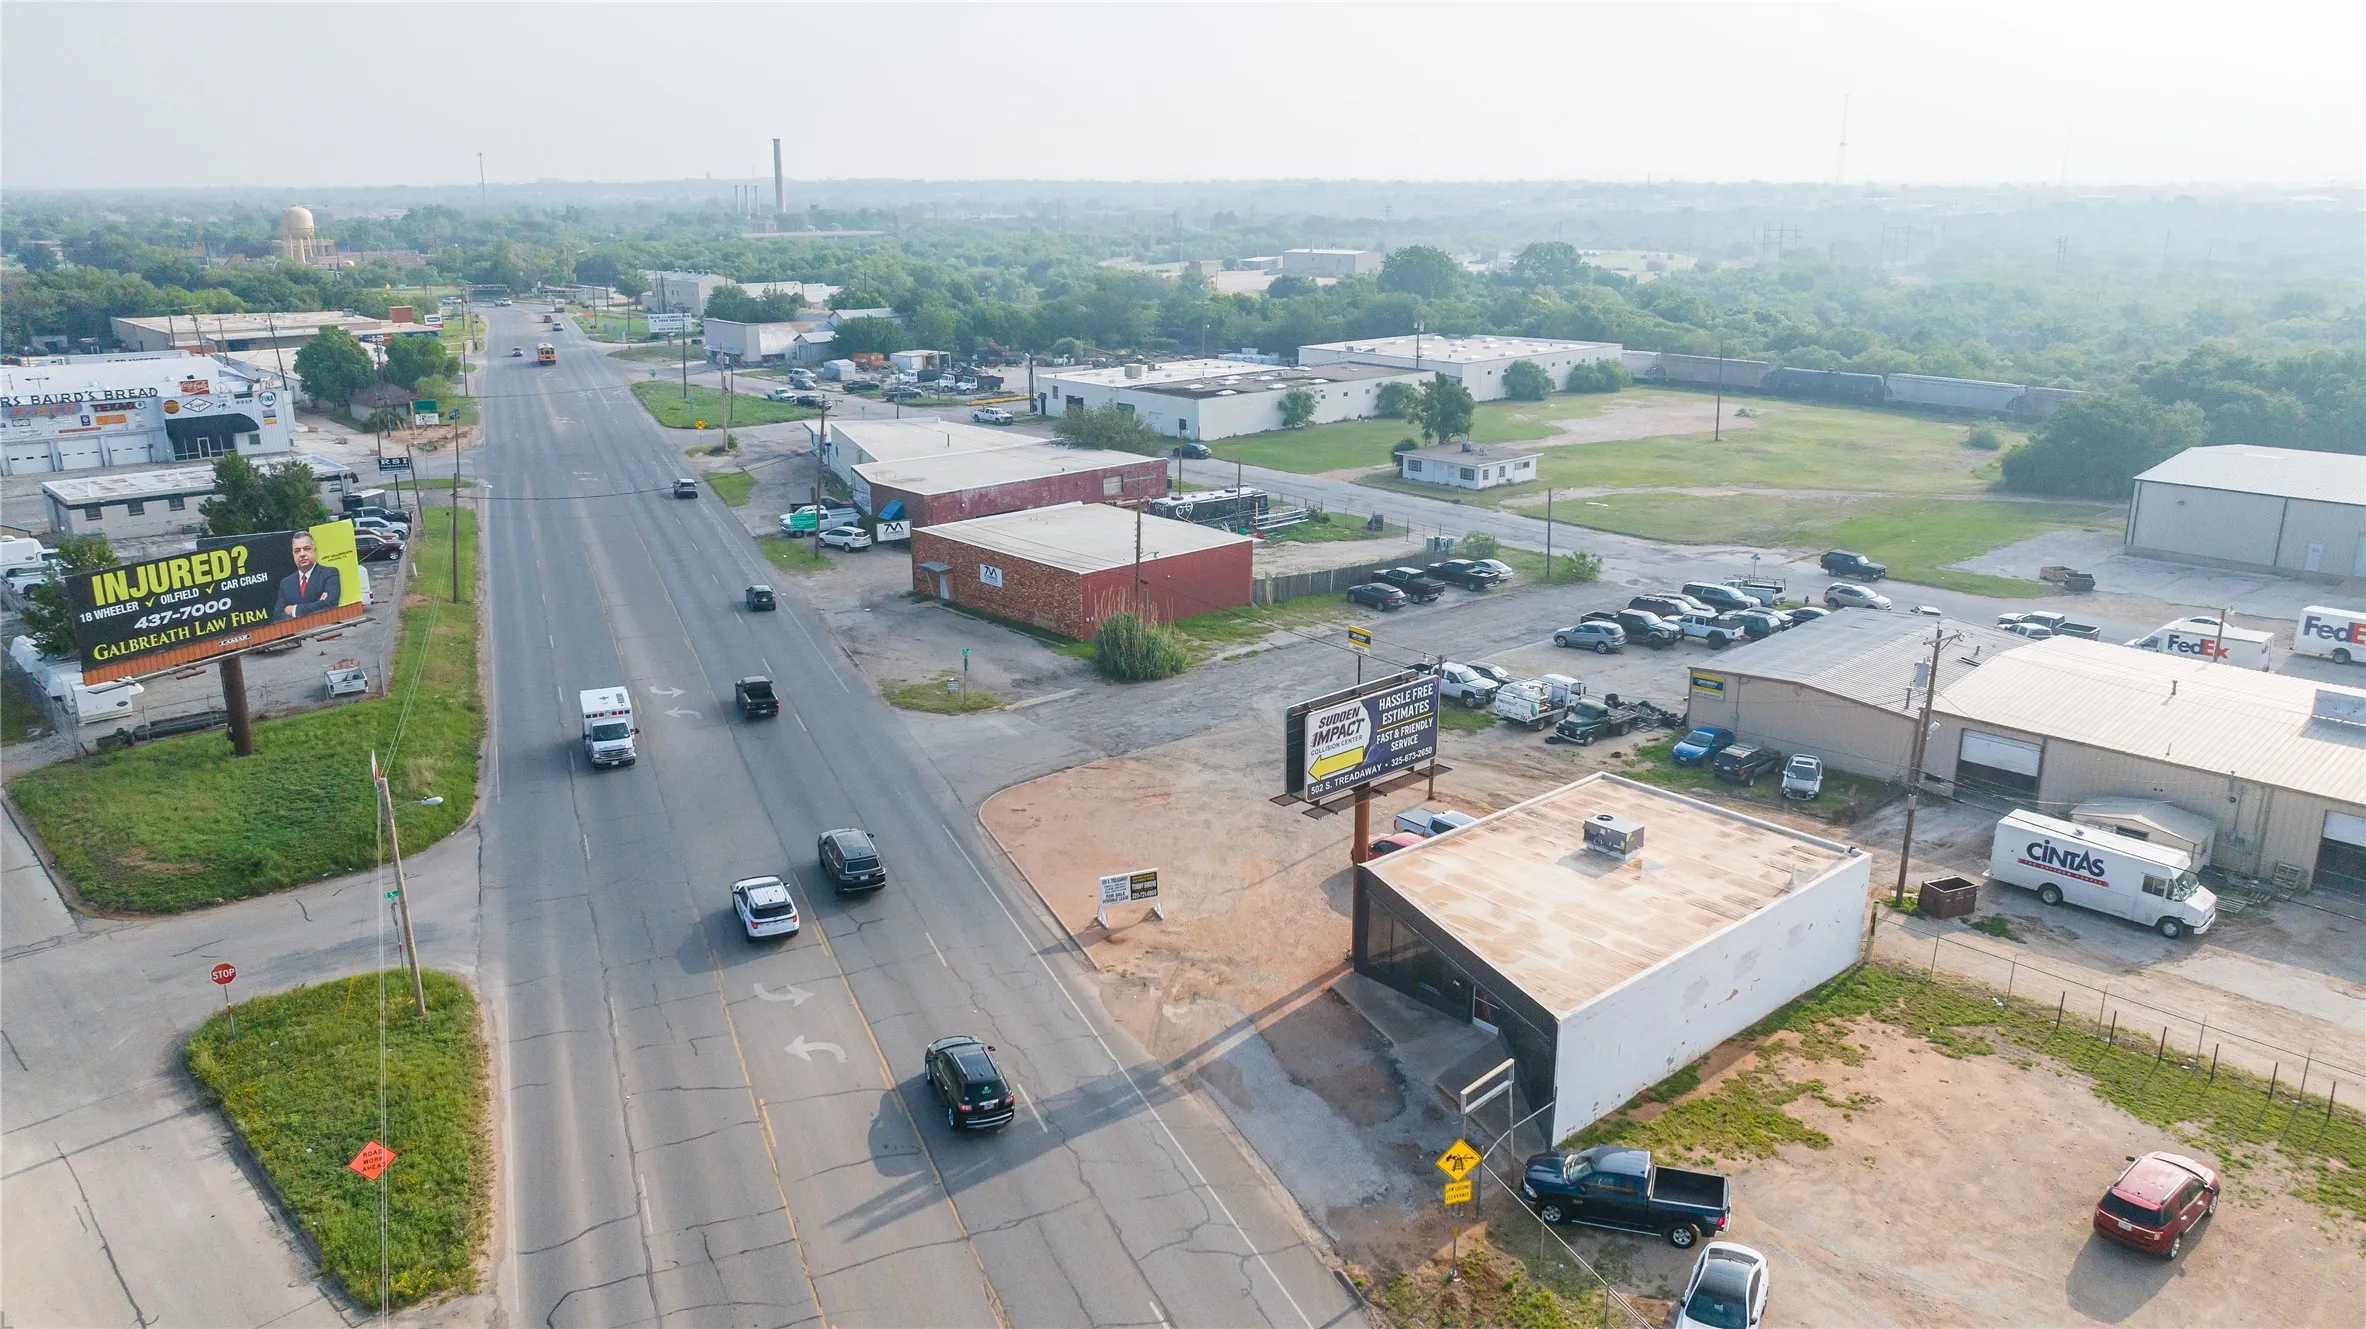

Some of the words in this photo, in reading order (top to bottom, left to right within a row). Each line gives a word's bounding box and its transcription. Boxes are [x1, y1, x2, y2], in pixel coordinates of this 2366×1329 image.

[30, 390, 98, 406] BAIRD'S
[104, 387, 159, 401] BREAD
[91, 545, 248, 606] INJURED?
[79, 612, 93, 623] 18
[93, 601, 140, 619] WHEELER
[160, 588, 200, 605] OILFIELD
[221, 580, 239, 591] CAR
[239, 572, 268, 587] CRASH
[134, 597, 232, 629] 437-7000
[2168, 634, 2230, 659] FedEx
[1379, 690, 1411, 711] HASSLE
[1412, 683, 1434, 701] FREE
[1319, 706, 1361, 729] SUDDEN
[1382, 699, 1430, 726] ESTIMATES
[1311, 718, 1366, 748] IMPACT
[1376, 730, 1394, 745] FAST
[1394, 728, 1400, 739] &
[1400, 717, 1434, 737] FRIENDLY
[1391, 734, 1419, 752] SERVICE
[1310, 743, 1340, 756] COLLISION
[1340, 734, 1363, 747] CENTER
[1311, 786, 1324, 795] 502
[1325, 781, 1333, 790] S.
[1335, 763, 1383, 786] TREADAWAY
[1391, 746, 1433, 767] 325-673-2650
[212, 968, 235, 979] STOP
[363, 1149, 382, 1157] ROAD
